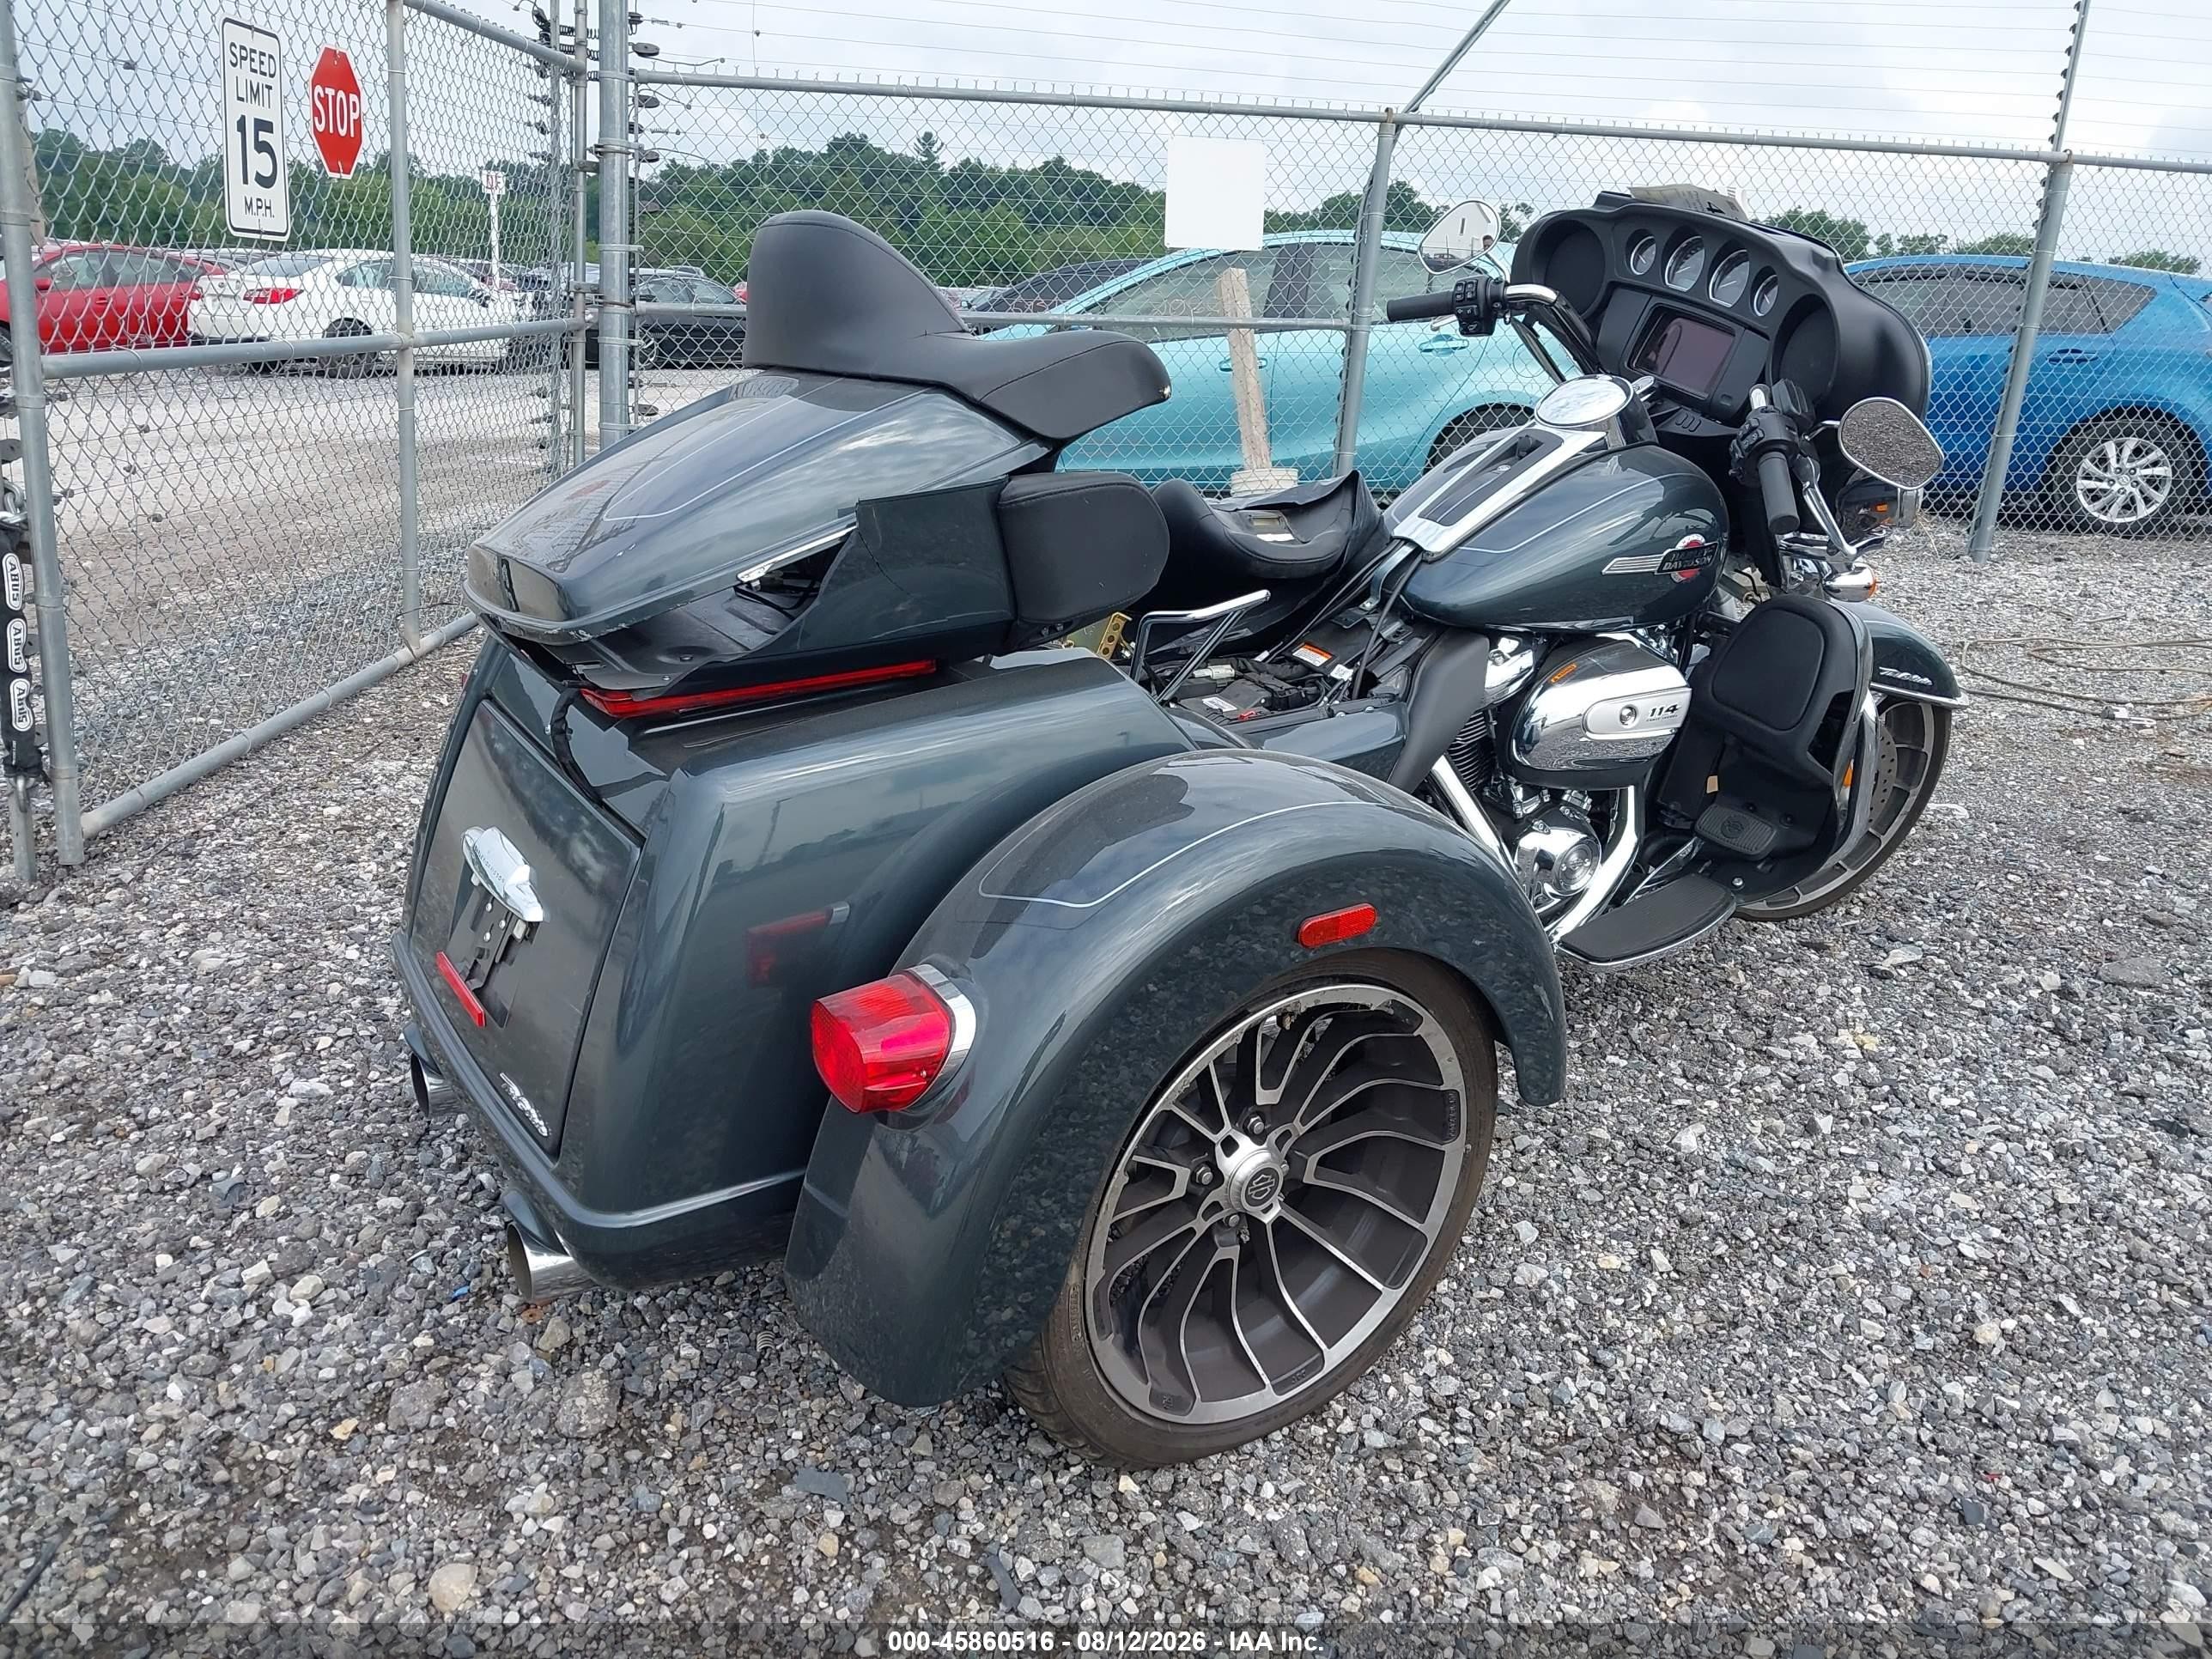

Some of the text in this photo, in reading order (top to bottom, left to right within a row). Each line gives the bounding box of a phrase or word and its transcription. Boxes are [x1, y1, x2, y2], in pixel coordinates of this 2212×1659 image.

[229, 42, 276, 78] SPEED
[236, 76, 273, 109] LIMIT
[313, 85, 361, 137] STOP
[236, 114, 277, 189] 15
[244, 196, 275, 218] M.P.H.
[9, 561, 21, 602] ABUS
[13, 626, 23, 665] ABUS
[16, 687, 28, 724] ABUS
[1650, 704, 1679, 717] 114
